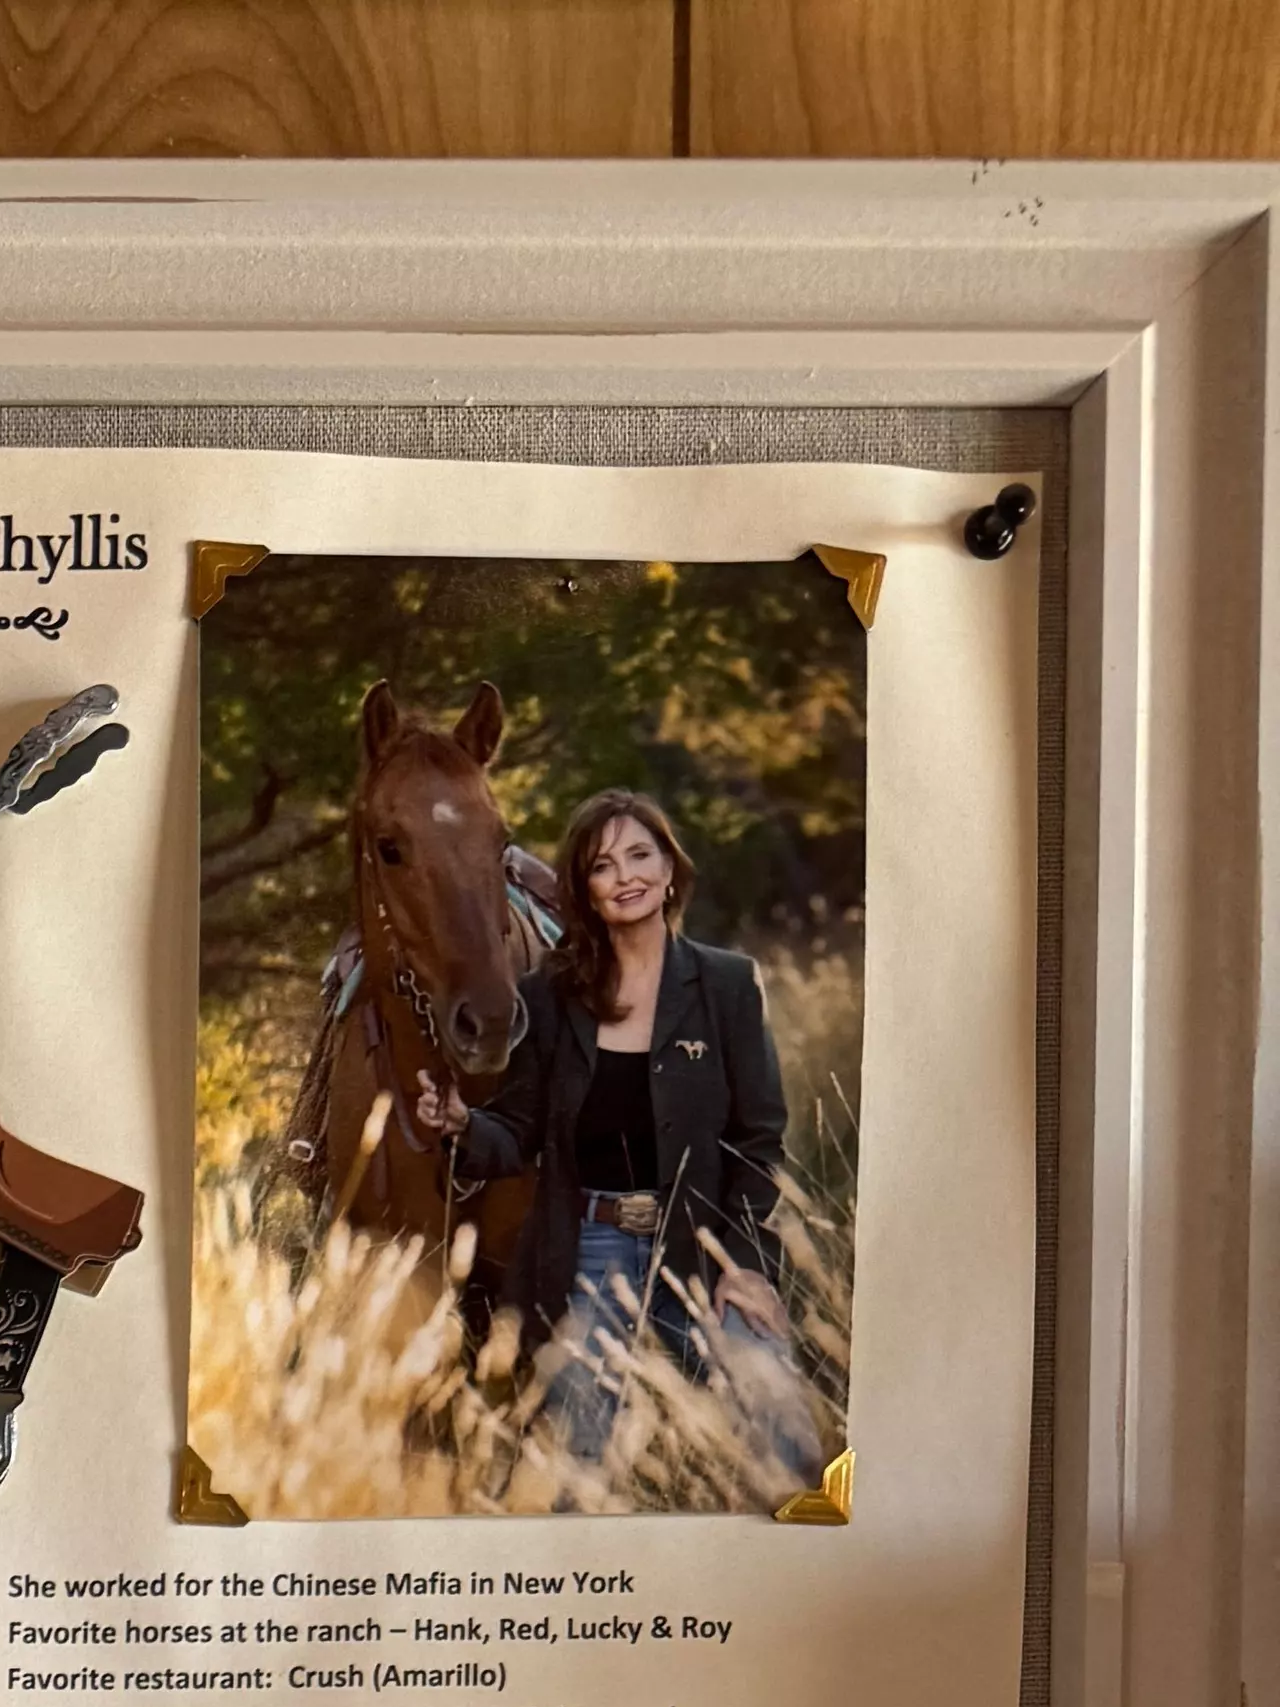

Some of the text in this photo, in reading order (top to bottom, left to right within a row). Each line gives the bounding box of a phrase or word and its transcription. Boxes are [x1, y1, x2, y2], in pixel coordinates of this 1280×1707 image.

[8, 1569, 634, 1598] She worked for the Chinese Mafia in New York
